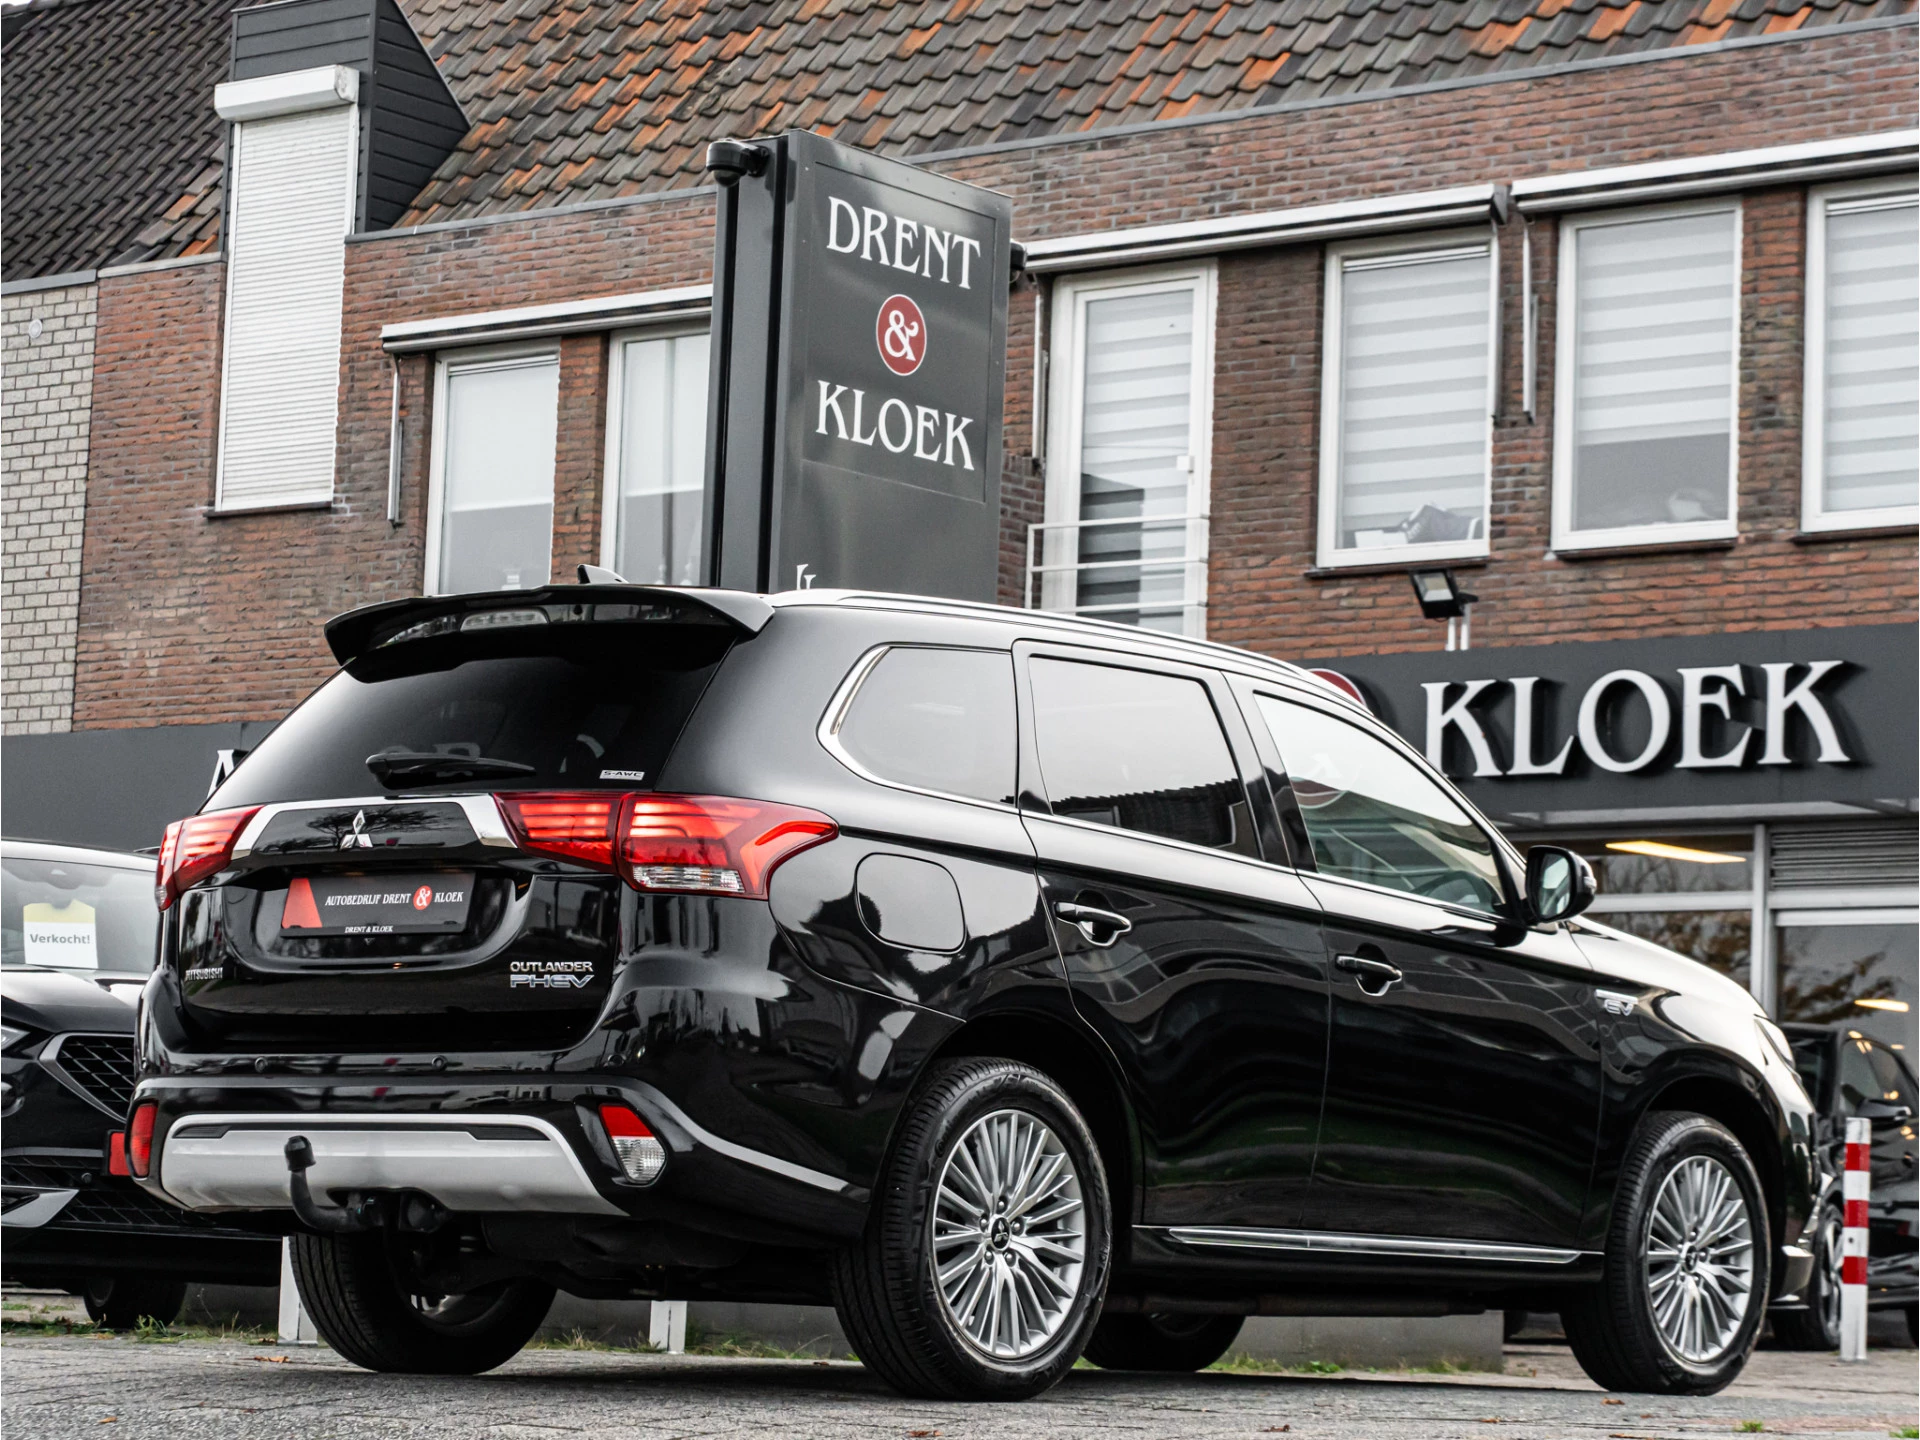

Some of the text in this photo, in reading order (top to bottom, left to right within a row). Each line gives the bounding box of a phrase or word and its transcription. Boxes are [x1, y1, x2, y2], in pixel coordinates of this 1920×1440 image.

[827, 196, 981, 289] DRENT
[884, 310, 919, 361] &
[816, 380, 975, 470] KLOEK
[1420, 660, 1850, 777] KLOEK
[325, 888, 464, 907] AUTOBEDRIJF DRENT & KLOEK
[30, 933, 91, 944] Verkocht!
[372, 925, 393, 933] KLOEK
[510, 961, 594, 972] OUTLANDER
[510, 974, 595, 988] PHEV
